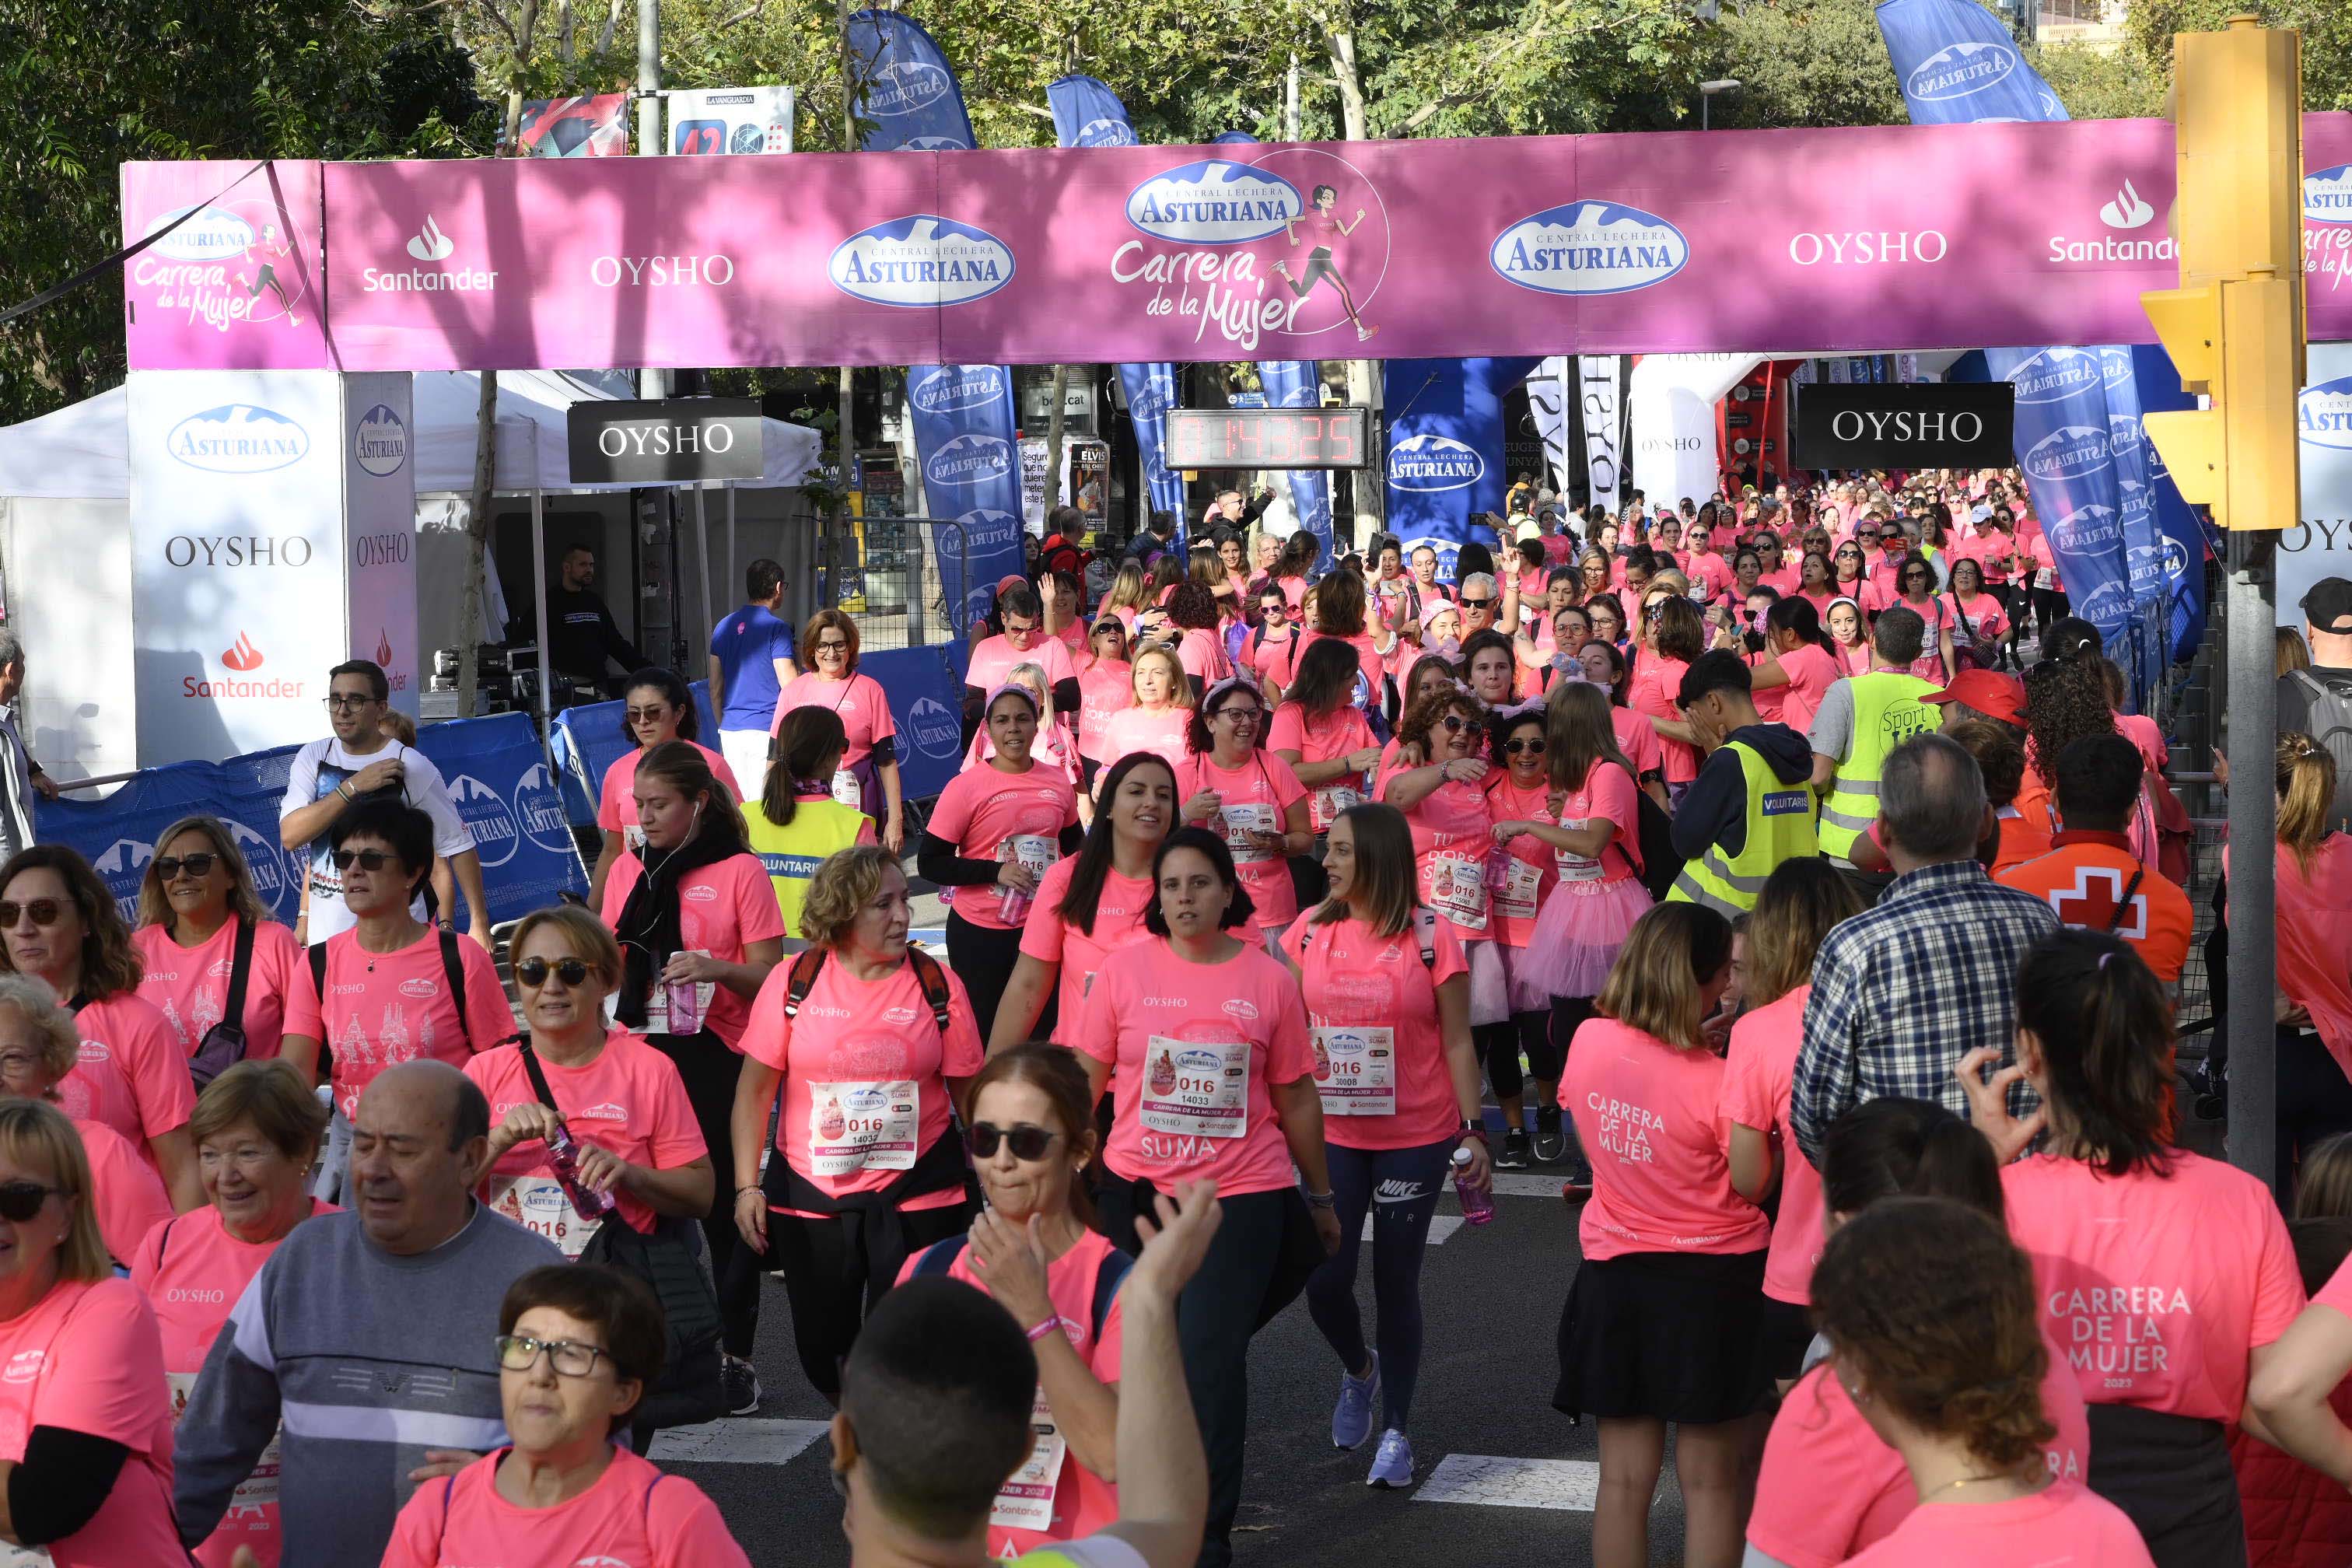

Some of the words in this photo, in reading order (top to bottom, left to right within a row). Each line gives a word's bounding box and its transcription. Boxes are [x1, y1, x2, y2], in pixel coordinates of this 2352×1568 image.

[1166, 188, 1223, 197] CENTRAL
[1228, 187, 1283, 196] LECHERA
[1139, 193, 1289, 223] ASTURIANA
[161, 232, 247, 247] STURIANA
[1537, 233, 1598, 243] CENTRAL
[1604, 232, 1667, 242] LECHERA
[1790, 232, 1947, 265] OYSHO
[871, 247, 932, 256] CENTRAL
[936, 246, 995, 255] LECHERA
[1111, 240, 1256, 283] Carrera
[1505, 237, 1674, 271] ASTURIANA
[2322, 250, 2336, 272] la
[134, 257, 227, 286] Carrera
[590, 254, 733, 286] OYSHO
[843, 250, 1001, 283] ASTURIANA
[363, 268, 499, 292] Santander
[157, 289, 174, 308] de
[178, 288, 189, 308] la
[188, 285, 261, 331] Mujer
[1146, 287, 1173, 316] de
[1180, 285, 1199, 316] la
[1195, 277, 1311, 350] Mujer
[2319, 400, 2352, 409] CENT
[1832, 411, 1983, 443] OYSHO
[179, 431, 299, 456] ASTURIANA
[359, 432, 404, 460] ASTURIANA
[599, 423, 733, 457] OYSHO
[1178, 418, 1353, 460] 01:43:25
[1081, 451, 1105, 460] ELVIS
[1024, 464, 1036, 473] que
[1024, 472, 1046, 482] quiere
[1389, 457, 1477, 479] ASTURIANA
[1024, 484, 1045, 492] mete
[165, 536, 312, 566] OYSHO
[356, 533, 408, 567] OYSHO
[183, 677, 304, 698] Santander
[1883, 705, 1926, 732] Sport
[1236, 869, 1260, 884] MA
[1455, 885, 1475, 898] 016
[810, 1005, 851, 1019] OYSHO
[1143, 996, 1188, 1008] OYSHO
[1332, 1062, 1361, 1074] 016
[1179, 1077, 1215, 1093] 016
[1153, 1104, 1181, 1114] CARRERA
[1181, 1095, 1209, 1105] 14033
[1587, 1092, 1665, 1132] CARRERA
[849, 1118, 883, 1132] 016
[1627, 1123, 1650, 1146] LA
[852, 1135, 878, 1144] 14032
[1141, 1136, 1216, 1158] SUMA
[822, 1160, 853, 1168] OYSHO
[1380, 1178, 1423, 1196] NIKE
[167, 1288, 225, 1304] OYSHO
[2049, 1286, 2192, 1318] CARRERA
[2072, 1316, 2113, 1343] DE
[2126, 1321, 2161, 1343] LA
[2068, 1346, 2168, 1373] MUJER
[2104, 1377, 2132, 1388] 2023
[2048, 1450, 2078, 1477] RA
